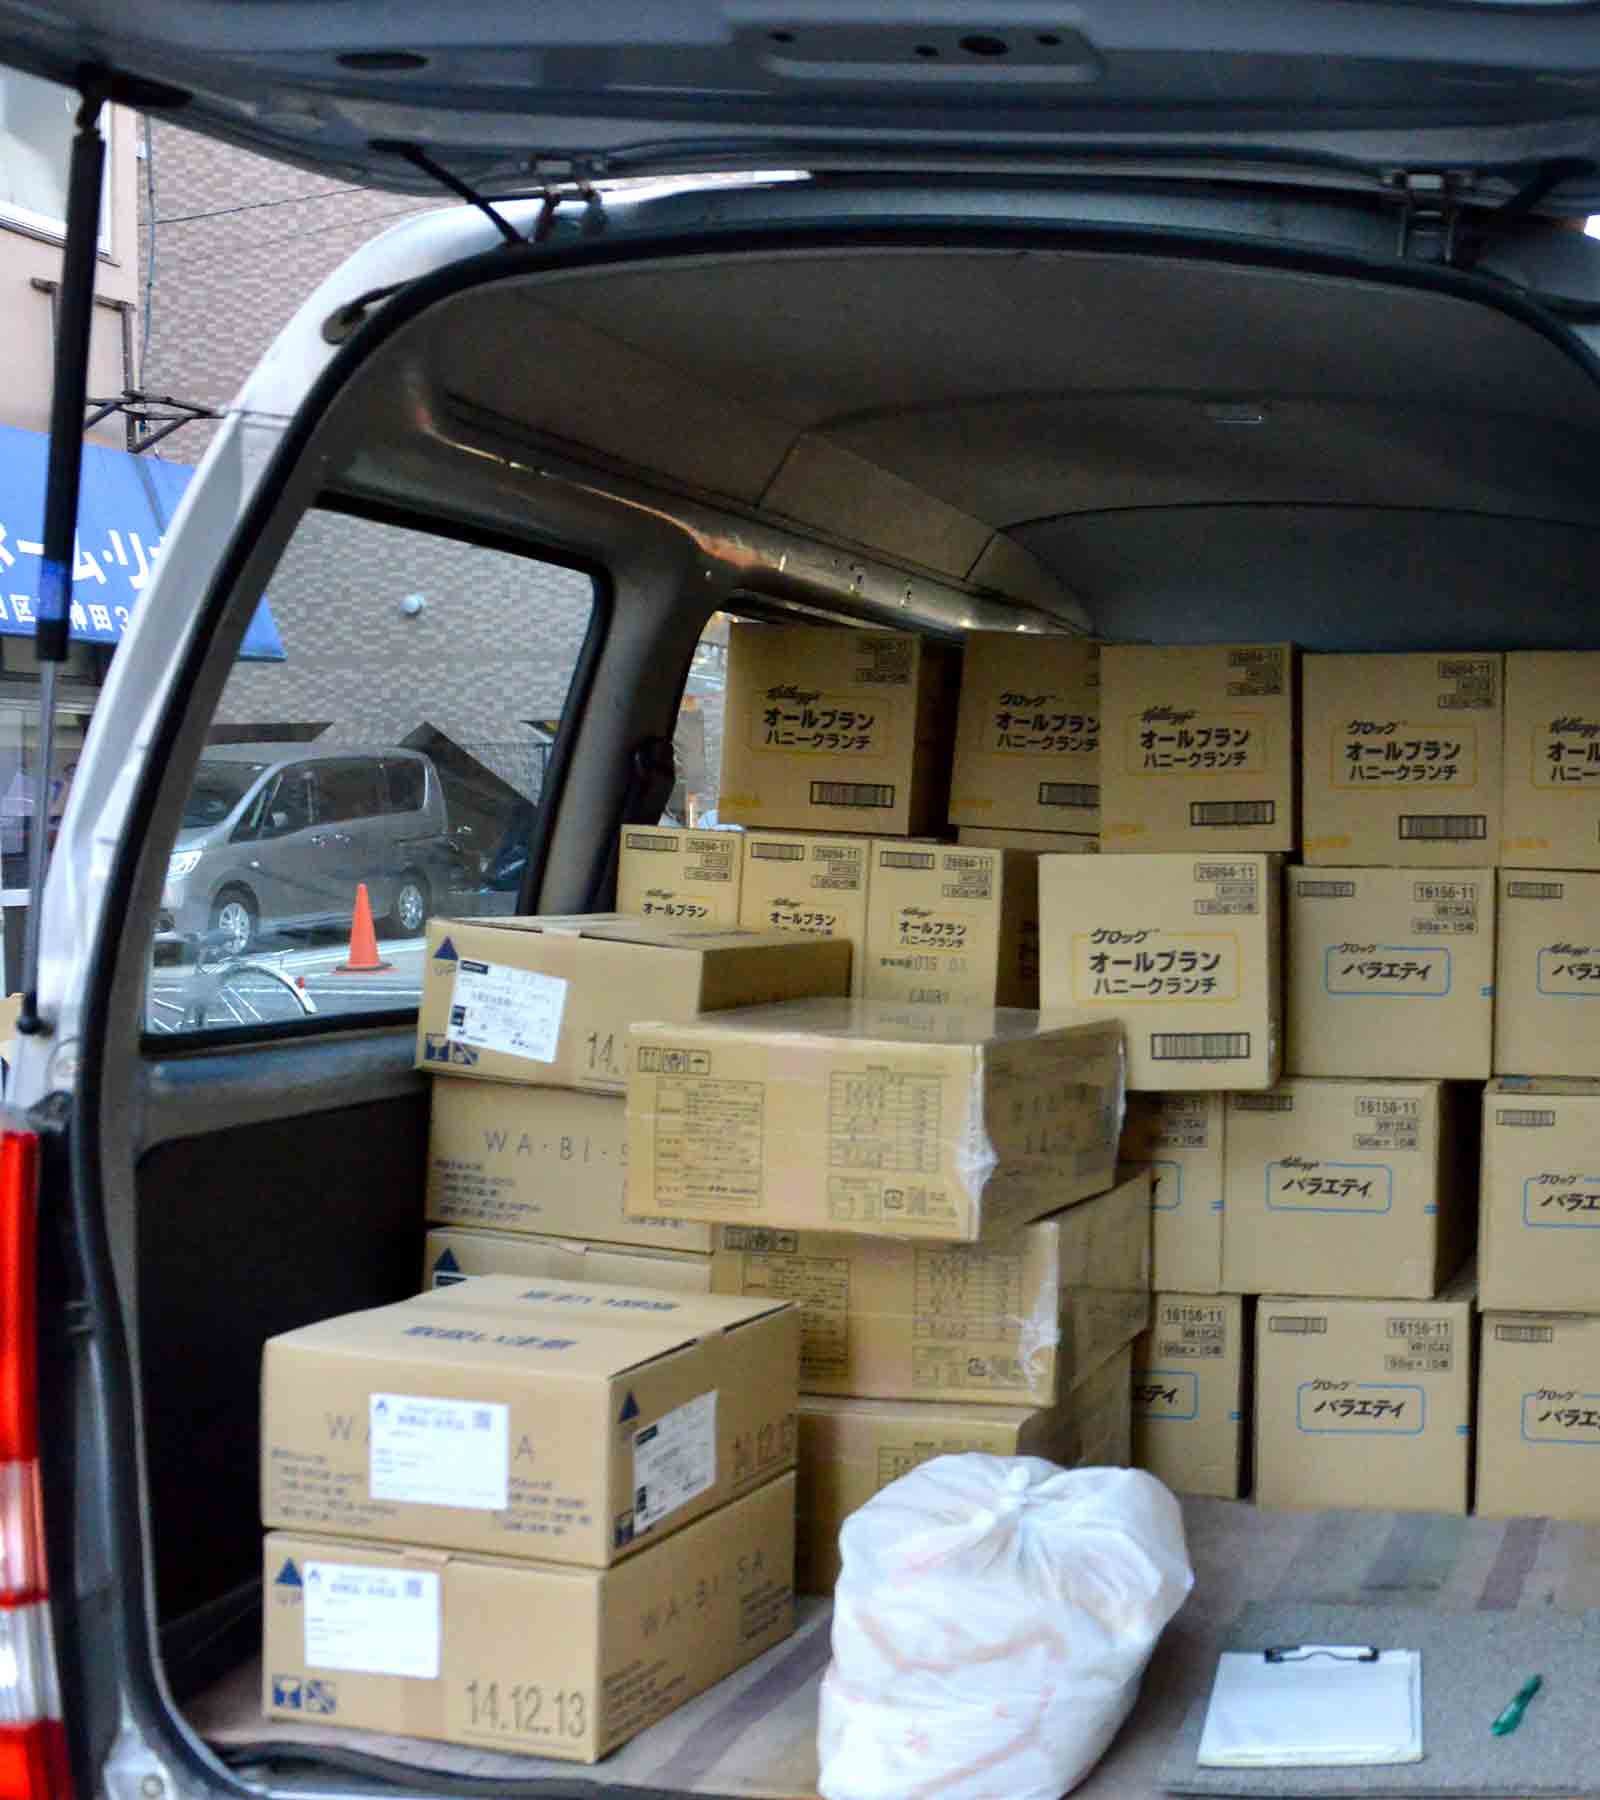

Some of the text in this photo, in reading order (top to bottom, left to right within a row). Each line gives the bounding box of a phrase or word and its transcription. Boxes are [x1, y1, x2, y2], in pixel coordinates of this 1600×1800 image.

[764, 706, 876, 732] オールブラン
[765, 729, 872, 750] ハニークランチ
[1140, 727, 1250, 751] オールブラン
[1143, 751, 1248, 769] ハニークランチ
[1346, 741, 1461, 761] オールブラン
[1350, 764, 1459, 781] ハニークランチ
[642, 902, 708, 918] オールブラン
[769, 911, 836, 927] オールブラン
[899, 920, 967, 936] オールブラン
[1090, 951, 1221, 974] オールブラン
[1342, 961, 1432, 981] バラエティ
[1094, 976, 1217, 996] ハニークランチ
[1282, 1177, 1374, 1197] バラエティ
[1314, 1400, 1406, 1419] バラエティ
[465, 1679, 587, 1739] 14.12.13
